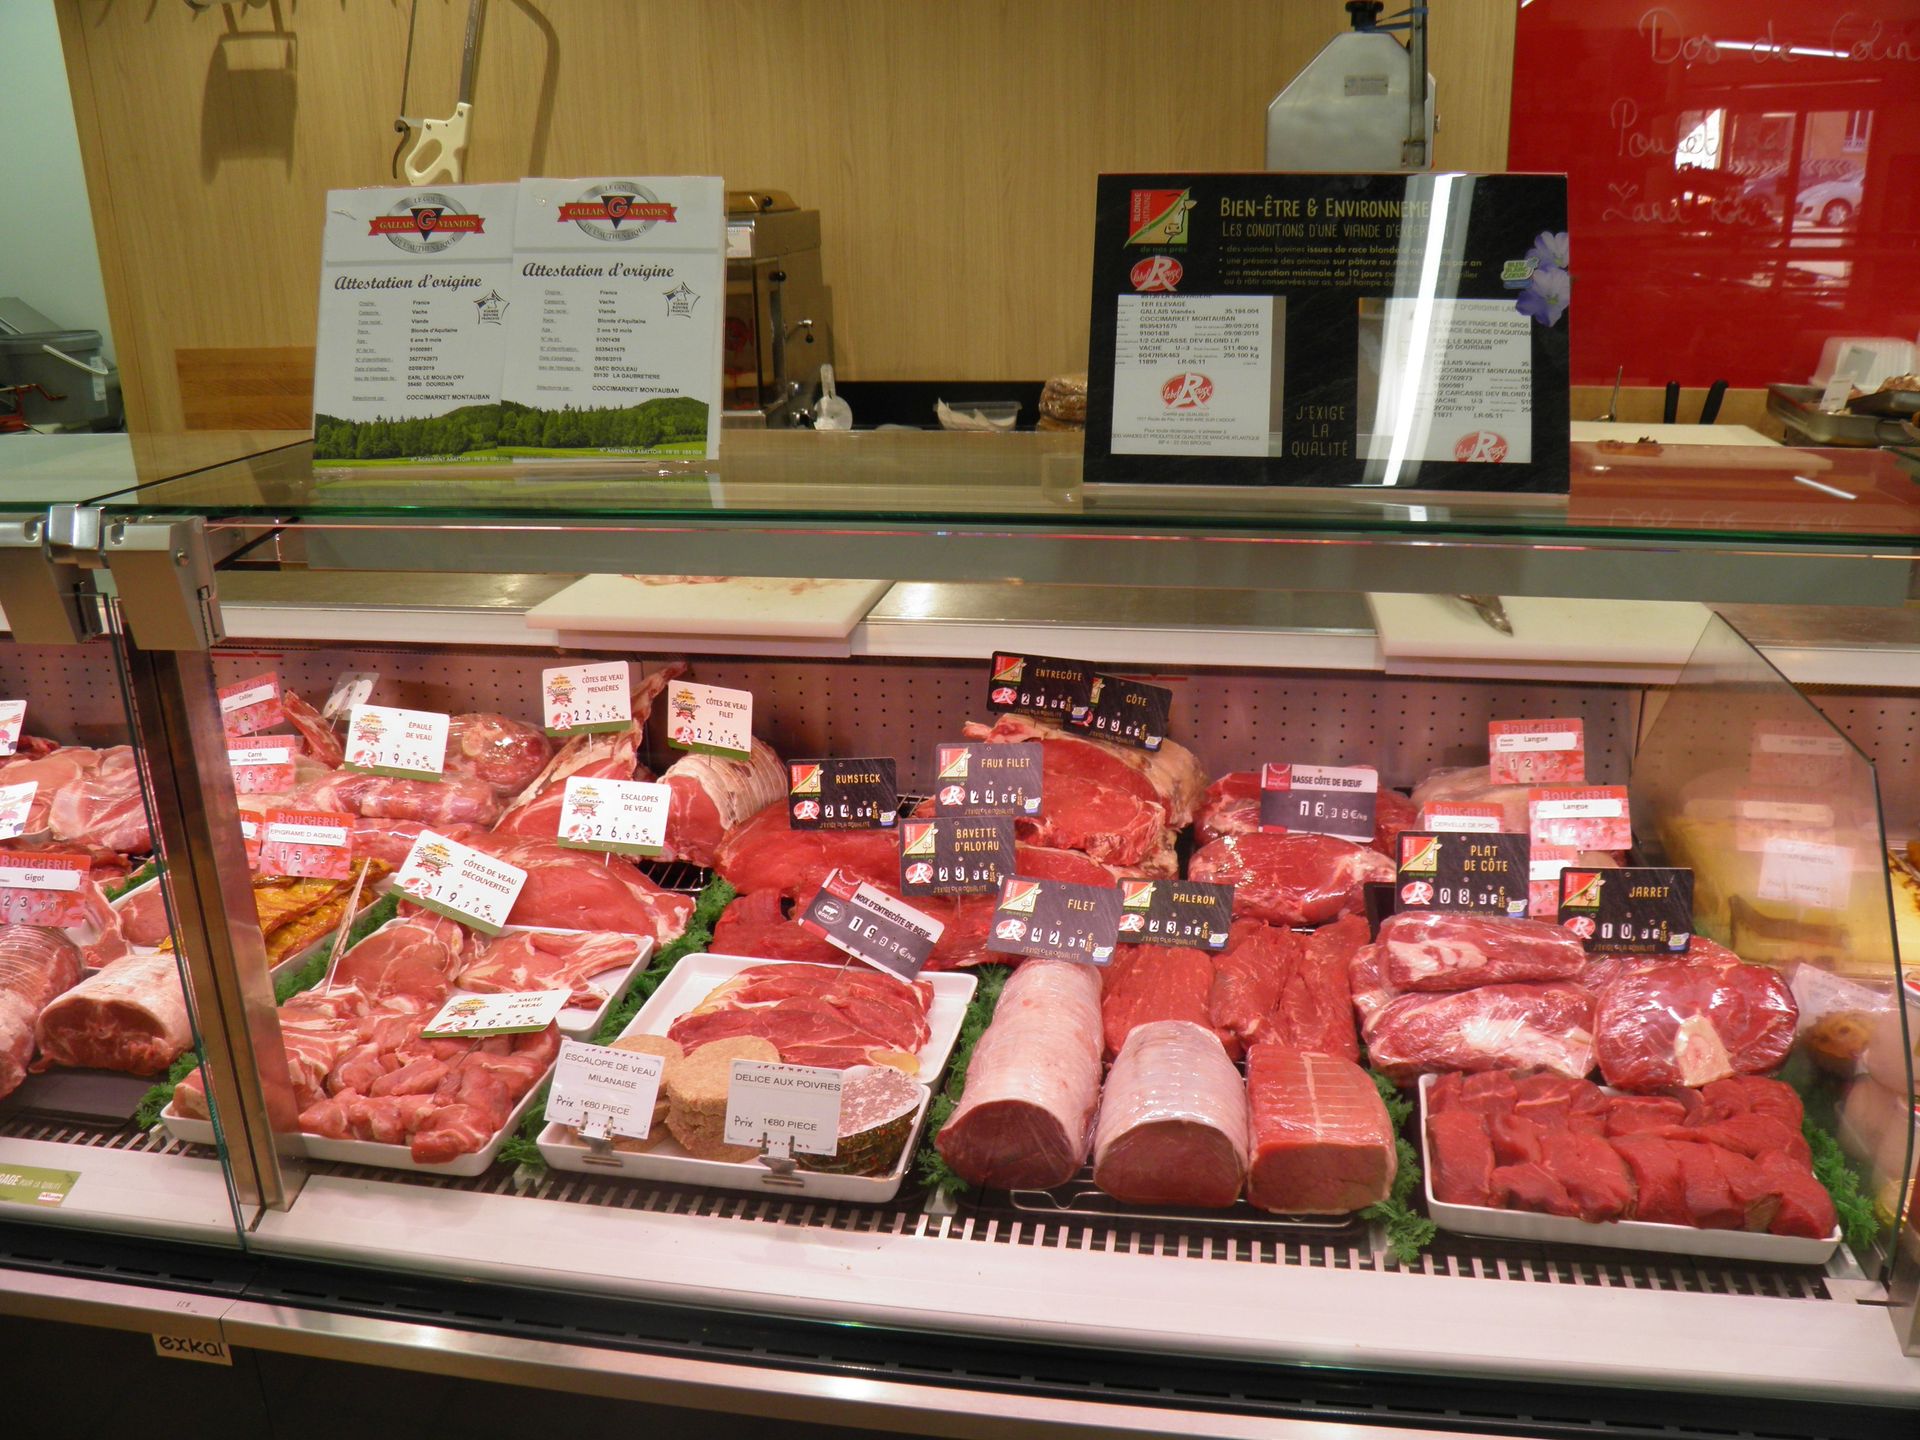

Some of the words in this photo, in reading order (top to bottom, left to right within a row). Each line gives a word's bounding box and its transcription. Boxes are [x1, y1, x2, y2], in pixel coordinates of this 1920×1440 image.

[569, 208, 605, 216] GALLAIS
[1220, 194, 1300, 218] BIEN-ÊTRE
[1307, 199, 1319, 218] &
[1326, 200, 1430, 218] ENVIRONNEME
[379, 219, 415, 230] GALLAIS
[438, 219, 477, 229] VIANDES
[1222, 223, 1242, 237] LES
[1246, 223, 1304, 238] CONDITIONS
[1309, 223, 1338, 238] D'UNE
[1343, 224, 1381, 238] VIANDE
[522, 262, 604, 278] Attestation
[608, 262, 675, 282] d'origine
[334, 275, 412, 290] Attestation
[418, 274, 482, 292] d'origine
[592, 385, 639, 393] COCCIMARKET
[1296, 406, 1345, 421] J'EXIGE
[1312, 423, 1329, 437] LA
[1291, 440, 1349, 457] QUALITÉ
[582, 675, 599, 684] CÔTES
[599, 674, 608, 682] DE
[608, 673, 624, 682] VEAU
[1035, 667, 1083, 682] ENTRECÔTE
[587, 683, 620, 694] PREMIÈRES
[705, 697, 723, 707] CÔTES
[723, 700, 731, 708] DE
[731, 701, 748, 711] VEAU
[1125, 693, 1148, 707] CÔTE
[718, 710, 734, 719] FILET
[408, 721, 433, 731] ÉPAULE
[405, 731, 415, 739] DE
[415, 733, 433, 742] VEAU
[981, 757, 1003, 769] FAUX
[1006, 757, 1030, 769] FILET
[835, 773, 881, 785] RUMSTECK
[1291, 775, 1313, 784] BASSE
[1313, 775, 1332, 786] CÔTE
[1332, 778, 1341, 787] DE
[621, 793, 659, 803] ESCALOPES
[624, 804, 632, 812] DE
[634, 805, 653, 813] VEAU
[278, 812, 341, 827] BOUCHERIE
[313, 832, 342, 840] AGNEAU
[956, 828, 998, 839] BAVETTE
[955, 840, 1000, 852] D'ALOYAU
[1470, 844, 1499, 857] PLAT
[3, 855, 74, 870] BOUCHERIE
[1464, 859, 1476, 872] DE
[1480, 857, 1509, 872] CÔTE
[24, 873, 45, 883] Gigot
[463, 859, 486, 873] CÔTES
[486, 866, 497, 877] DE
[497, 871, 518, 886] VEAU
[461, 869, 510, 895] DÉCOUVERTES
[1172, 892, 1217, 906] PALERON
[1628, 886, 1670, 899] JARRET
[854, 893, 870, 906] NOIX
[904, 921, 914, 931] DE
[1067, 898, 1096, 912] FILET
[564, 1052, 614, 1069] ESCALOPE
[616, 1062, 629, 1072] DE
[631, 1066, 657, 1077] VEAU
[588, 1073, 638, 1090] MILANAISE
[735, 1072, 772, 1084] DELICE
[773, 1078, 794, 1087] AUX
[796, 1080, 841, 1092] POIVRES
[556, 1094, 575, 1108] Prix
[580, 1099, 600, 1110] 1€80
[602, 1103, 631, 1116] PIECE
[734, 1115, 754, 1128] Prix
[763, 1118, 785, 1128] 1€80
[787, 1120, 818, 1132] PIECE
[159, 1335, 225, 1358] exkal
